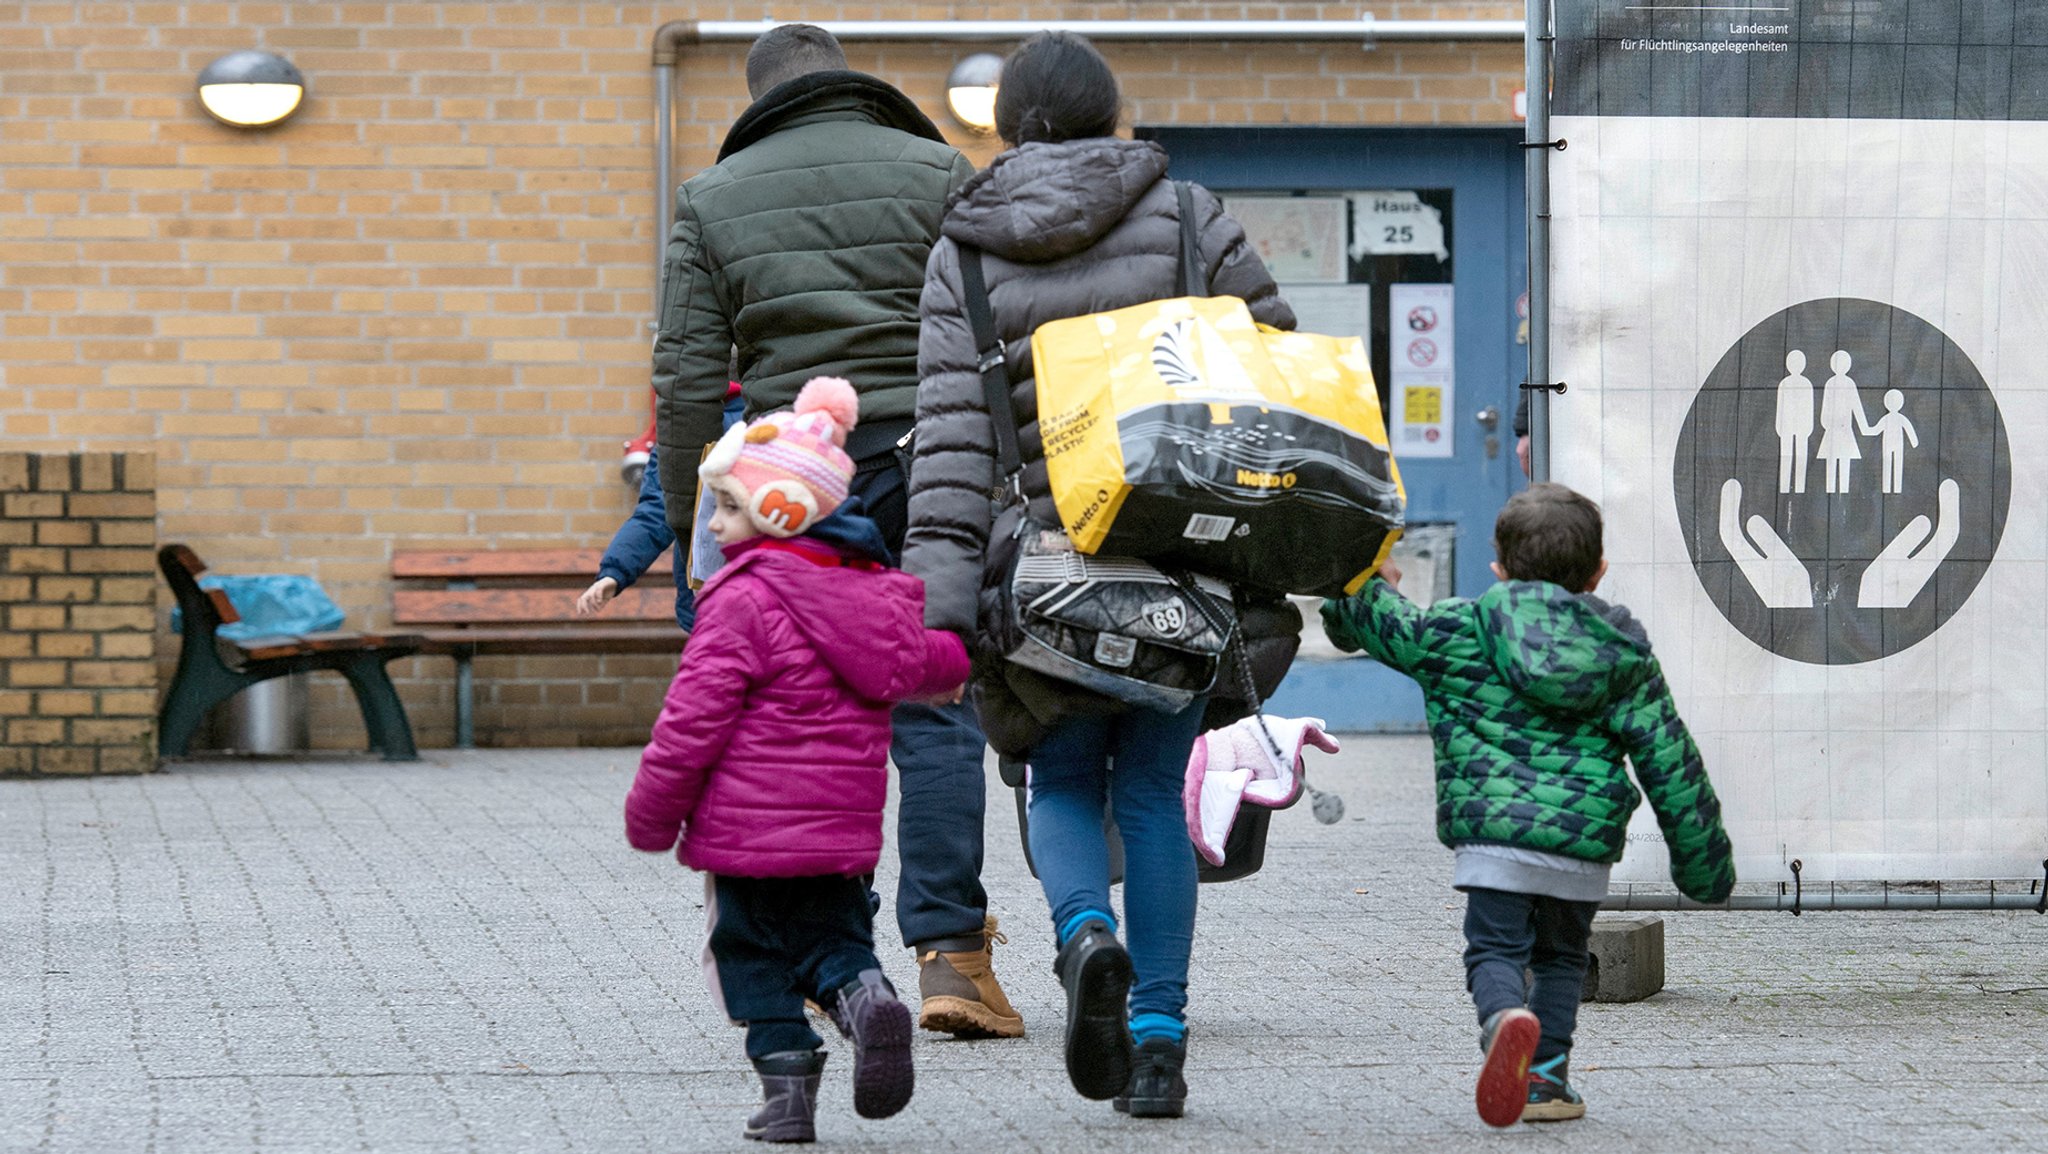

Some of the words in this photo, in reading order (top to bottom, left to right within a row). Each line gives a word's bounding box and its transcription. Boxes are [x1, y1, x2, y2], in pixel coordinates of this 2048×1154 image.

[1729, 23, 1789, 35] Landesamt
[1620, 39, 1636, 51] für
[1639, 39, 1788, 54] Flüchtlingsangelegenheiten
[1374, 200, 1421, 213] Haus
[1384, 226, 1413, 243] 25
[1058, 409, 1090, 429] FROM
[1236, 469, 1281, 488] Netto
[1072, 502, 1099, 536] Netto
[1152, 607, 1181, 632] 69
